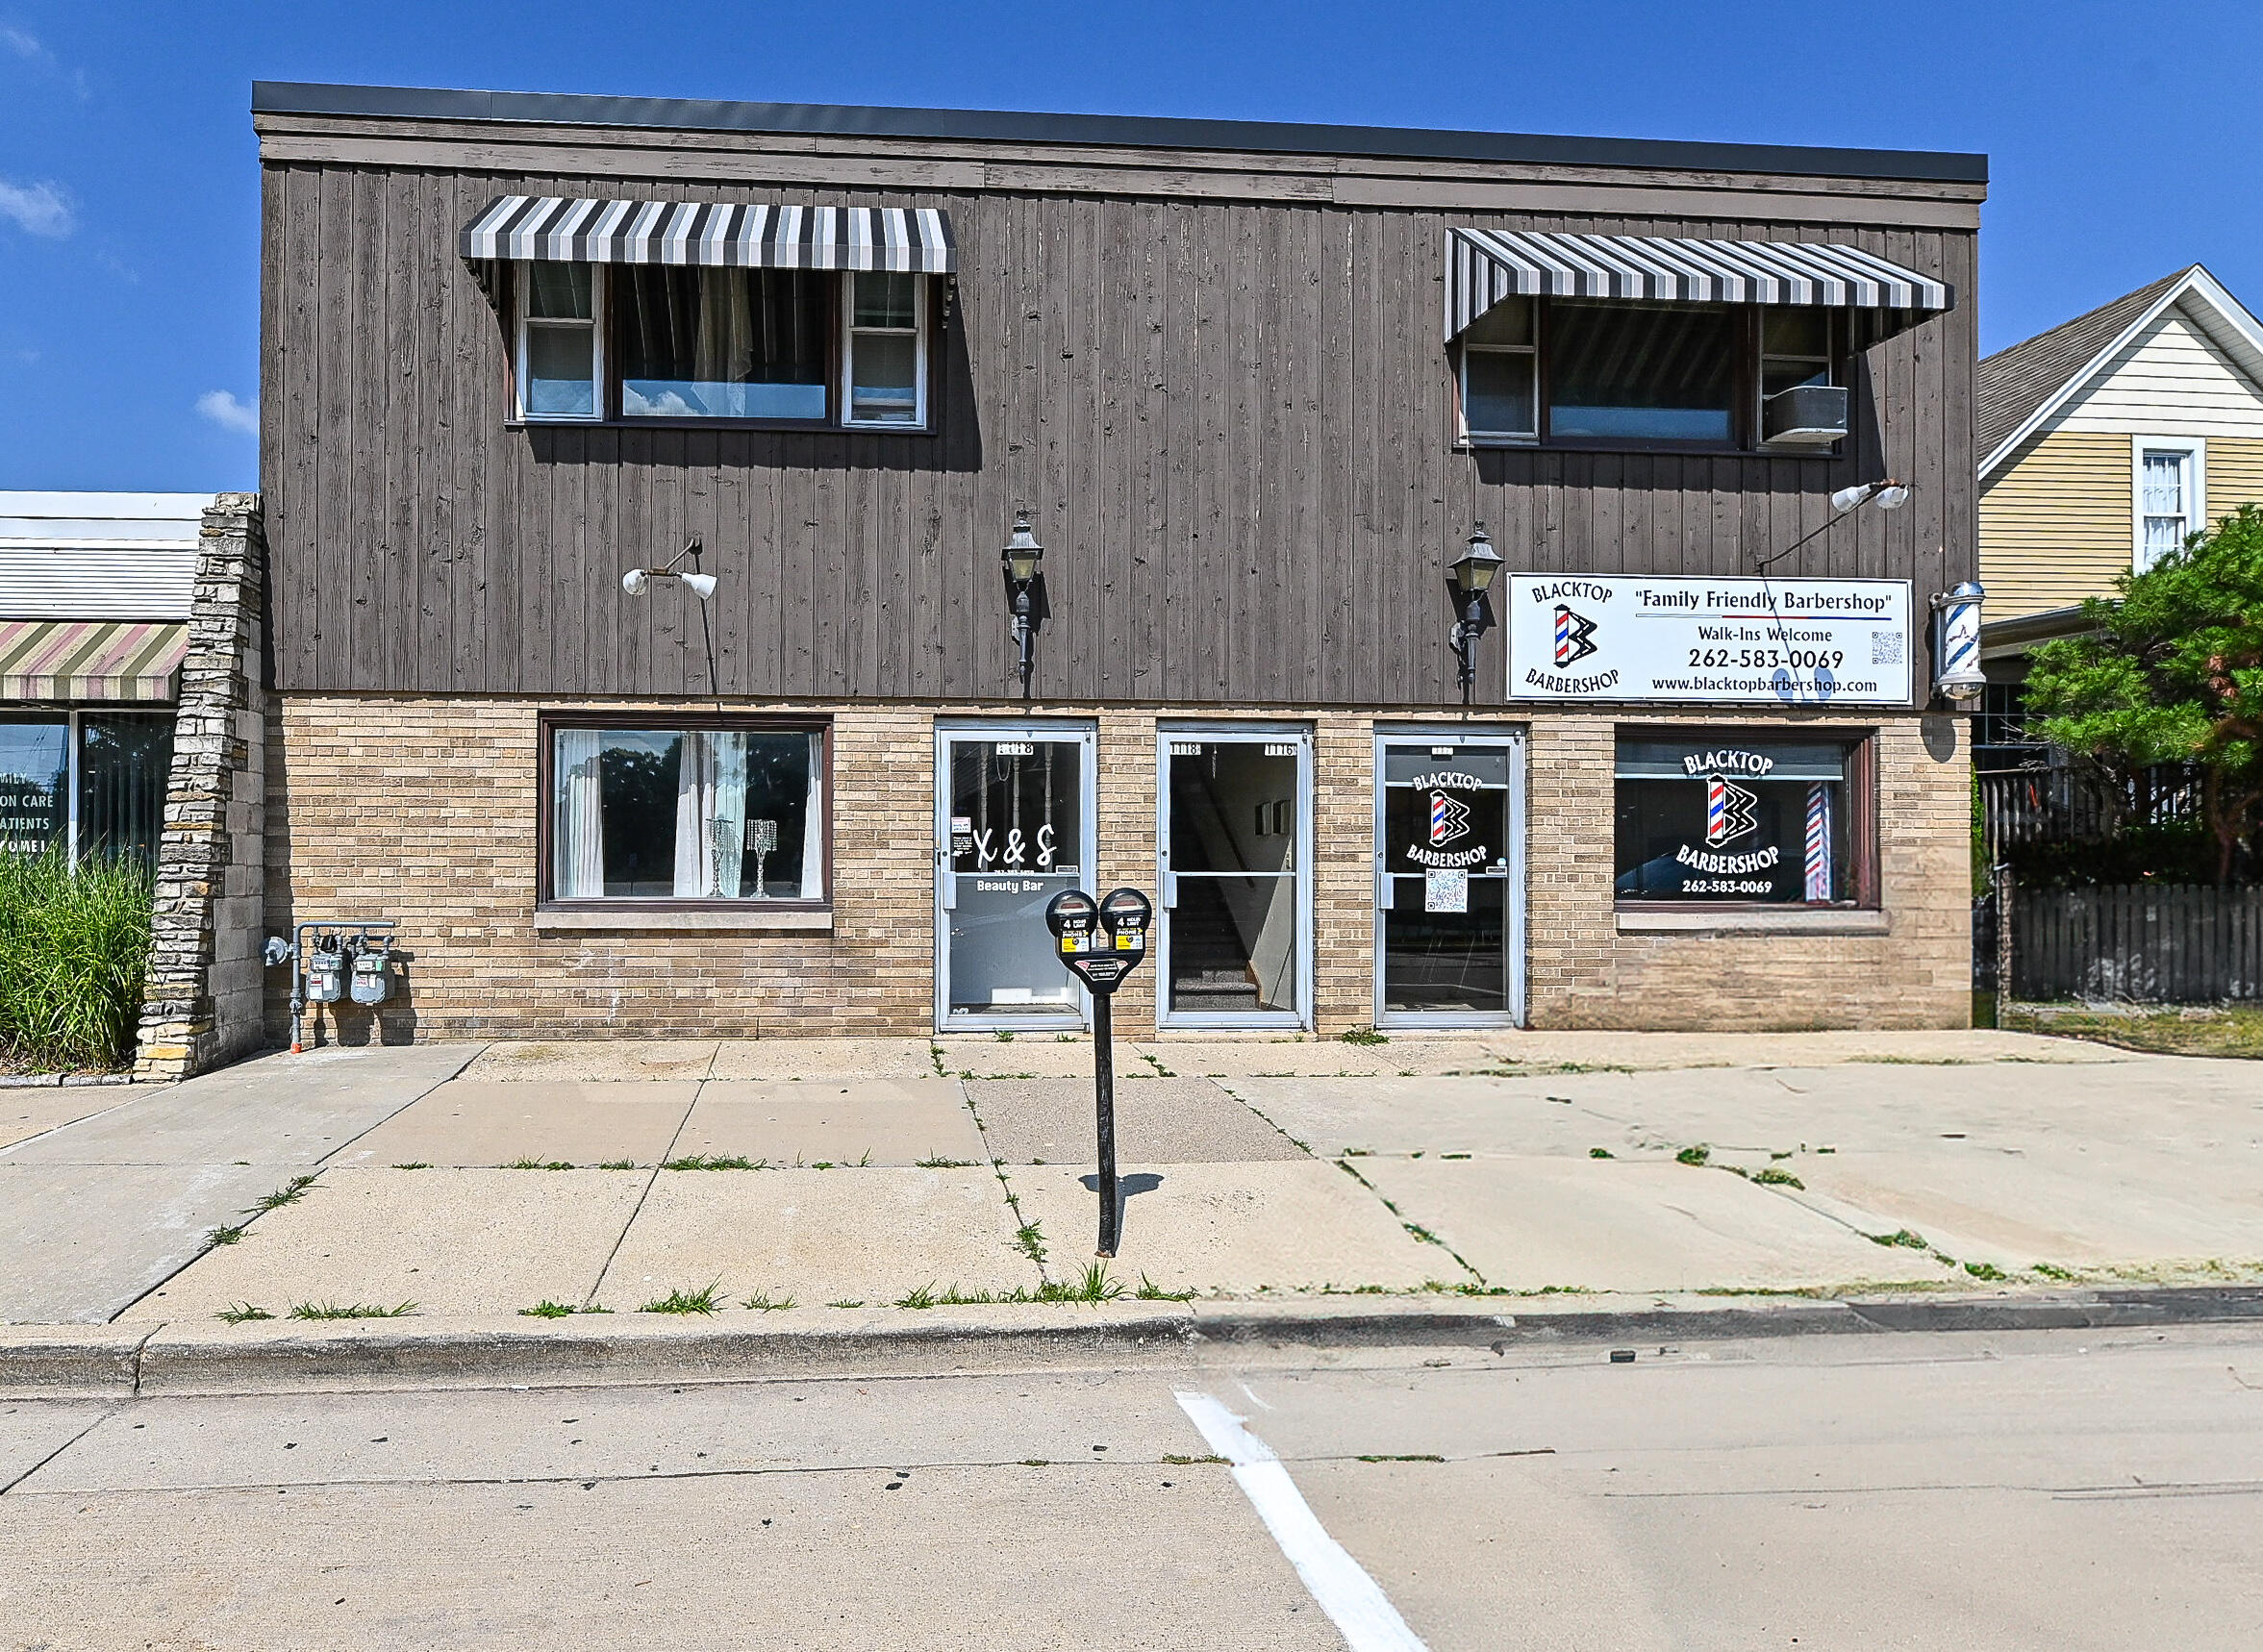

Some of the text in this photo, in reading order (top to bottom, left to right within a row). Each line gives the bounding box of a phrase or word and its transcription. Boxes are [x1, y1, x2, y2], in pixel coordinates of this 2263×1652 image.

[1531, 581, 1613, 604] BLACKTOP
[1635, 589, 1893, 613] "Family Friendly Barbershop"
[1697, 625, 1832, 641] Walk-Ins Welcome
[1688, 648, 1844, 668] 262-583-0069
[1525, 667, 1619, 693] BARBERSHOP
[1652, 676, 1877, 692] www.blacktopbarbershop.com
[1684, 749, 1773, 776] BLACKTOP
[1413, 771, 1483, 791] BLACKTOP
[0, 794, 54, 808] ON CARE
[0, 816, 50, 830] ATIENTS
[972, 827, 998, 869] X
[1002, 828, 1026, 864] &
[1036, 823, 1058, 866] S
[1406, 843, 1488, 867] BARBERSHOP
[1675, 844, 1779, 874] BARBERSHOP
[976, 880, 1044, 894] Beauty Bar
[1682, 880, 1773, 893] 262-583-0069
[1063, 919, 1071, 929] 4
[1117, 916, 1125, 927] 4
